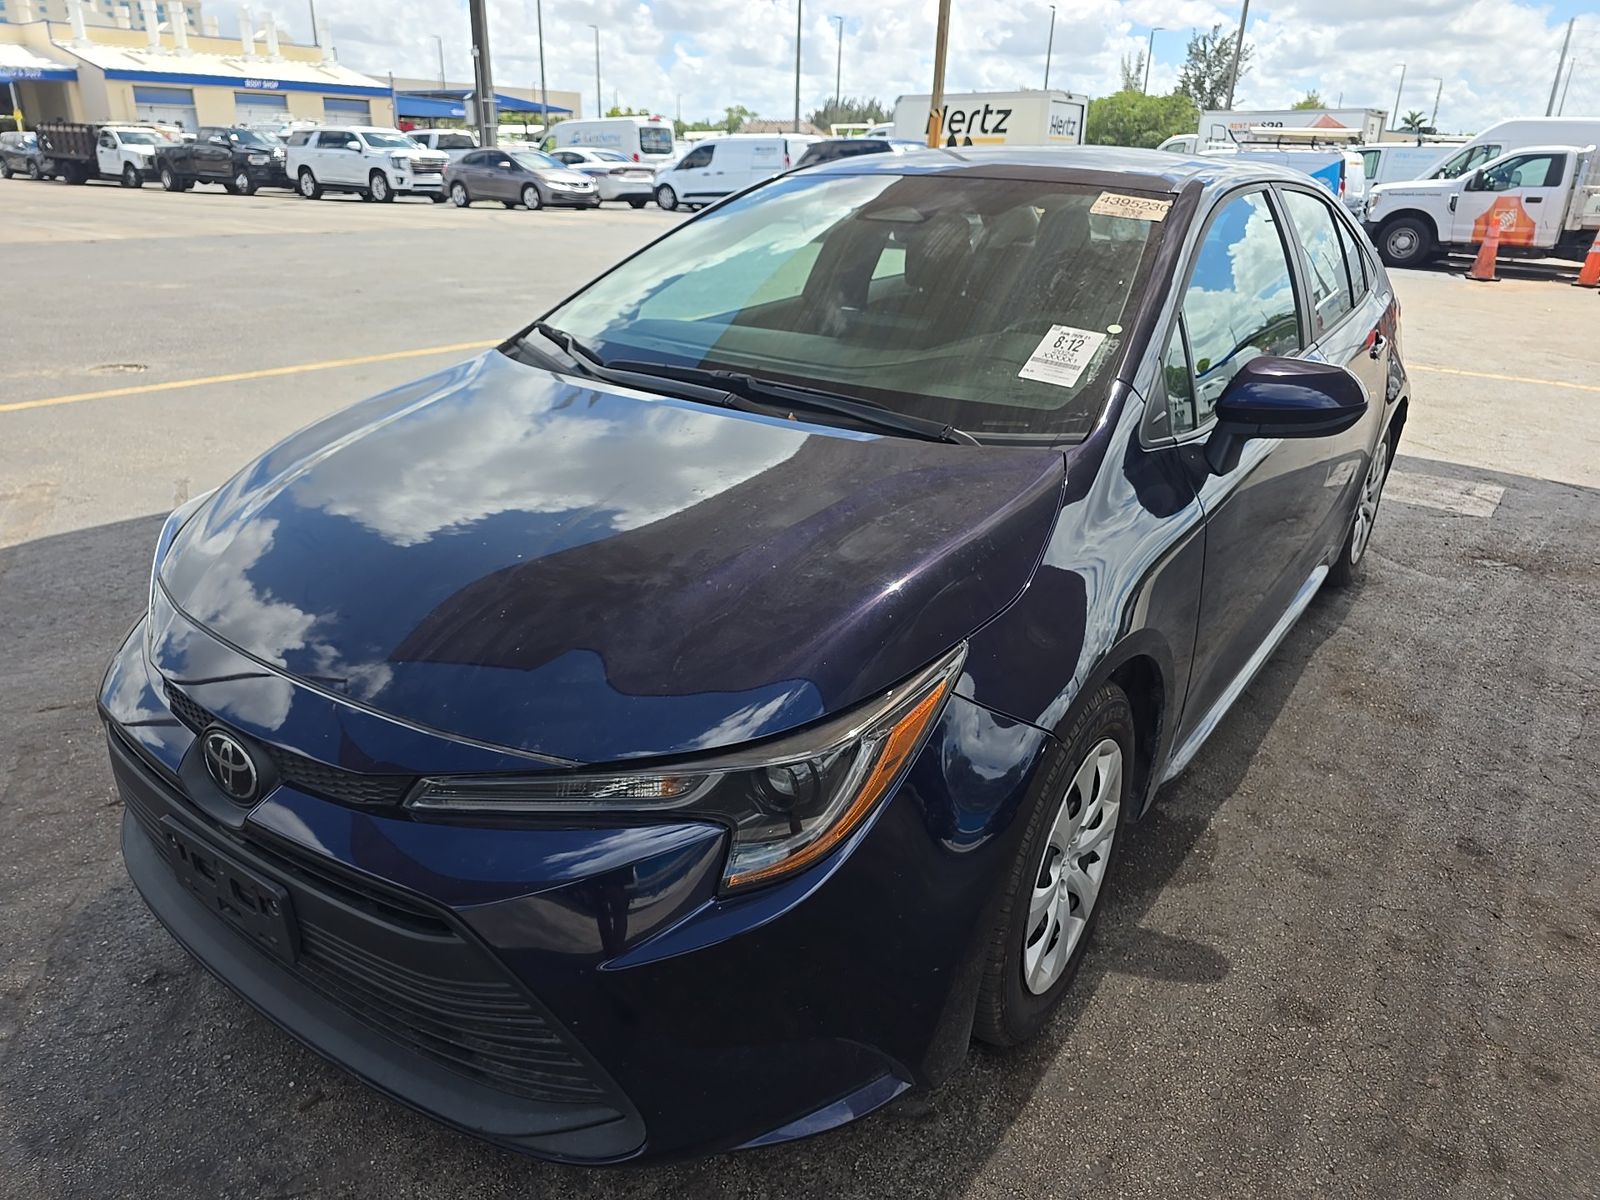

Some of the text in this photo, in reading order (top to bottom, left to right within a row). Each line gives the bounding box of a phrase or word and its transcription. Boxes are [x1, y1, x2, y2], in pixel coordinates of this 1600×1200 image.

[925, 104, 1012, 134] Hertz
[1049, 115, 1076, 136] Hertz
[1053, 335, 1085, 353] 8:12
